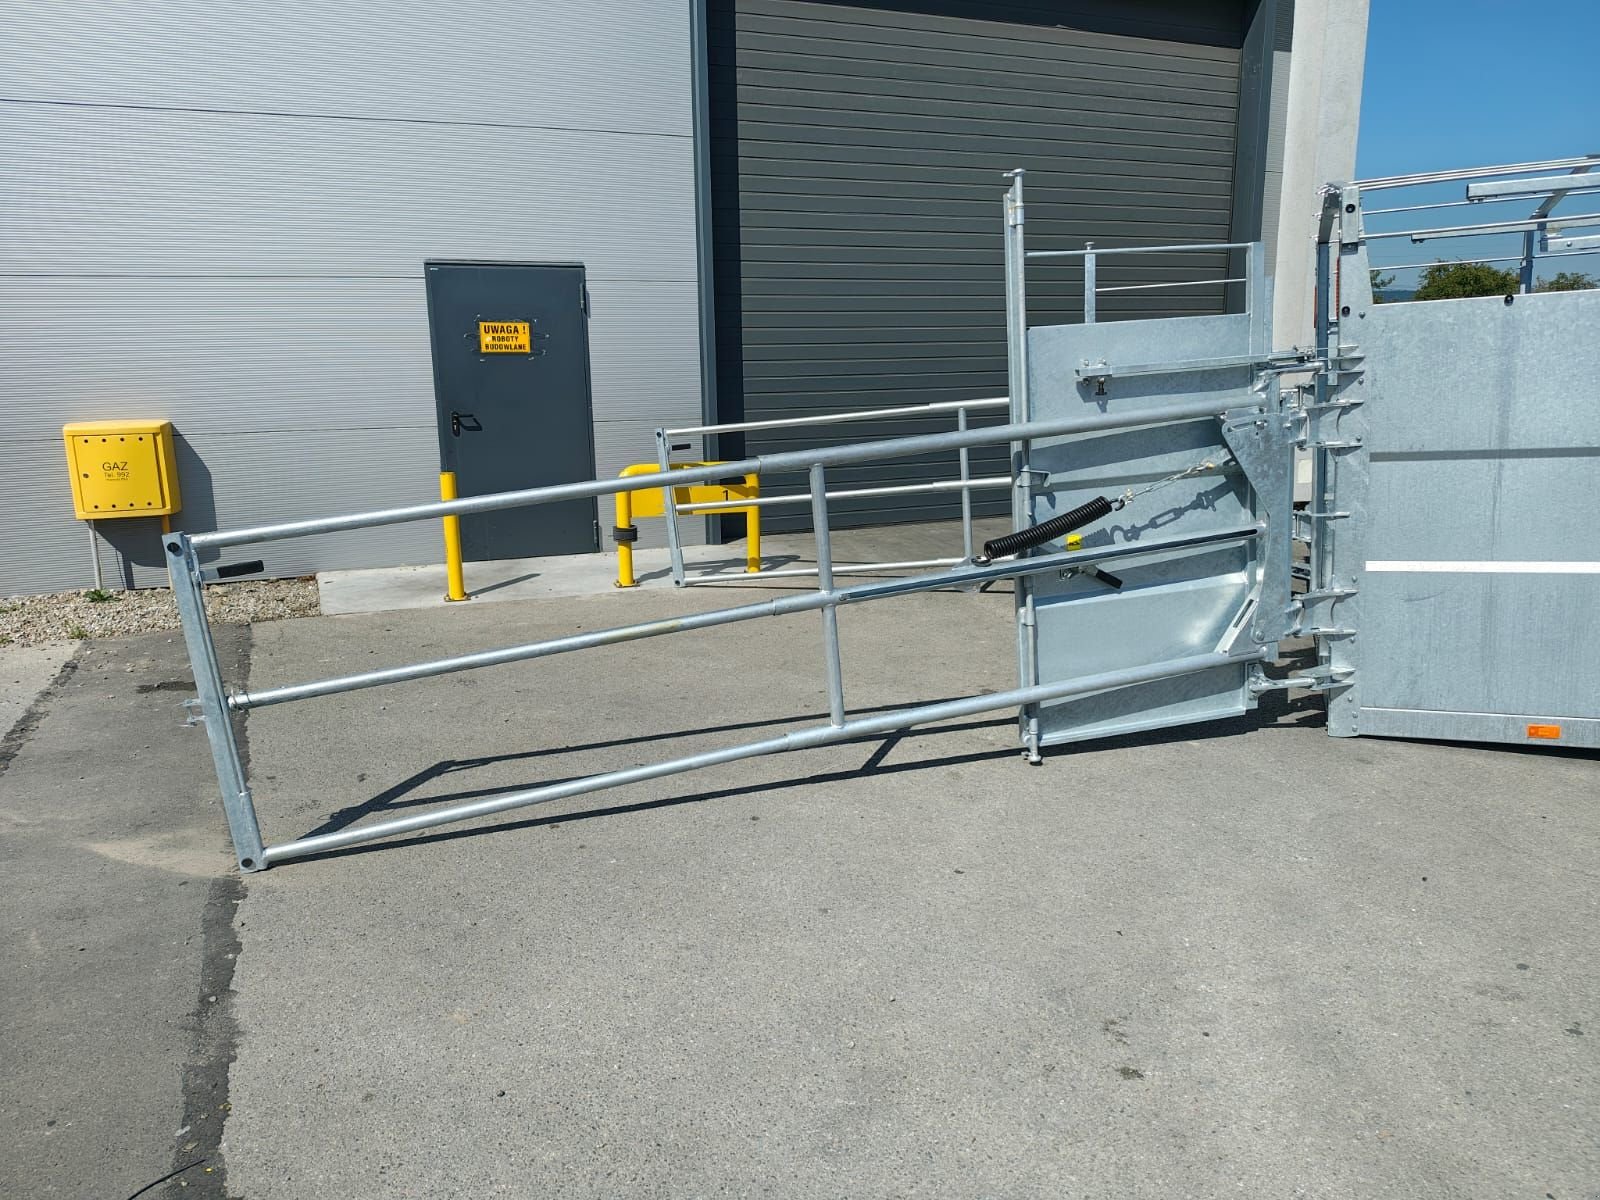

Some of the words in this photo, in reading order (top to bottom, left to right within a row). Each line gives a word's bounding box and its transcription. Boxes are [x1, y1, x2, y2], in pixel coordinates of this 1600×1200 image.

[483, 324, 519, 334] UWAGA
[491, 335, 519, 343] ROBOTY
[484, 343, 527, 351] BUDOWLANE
[102, 461, 129, 471] GAZ
